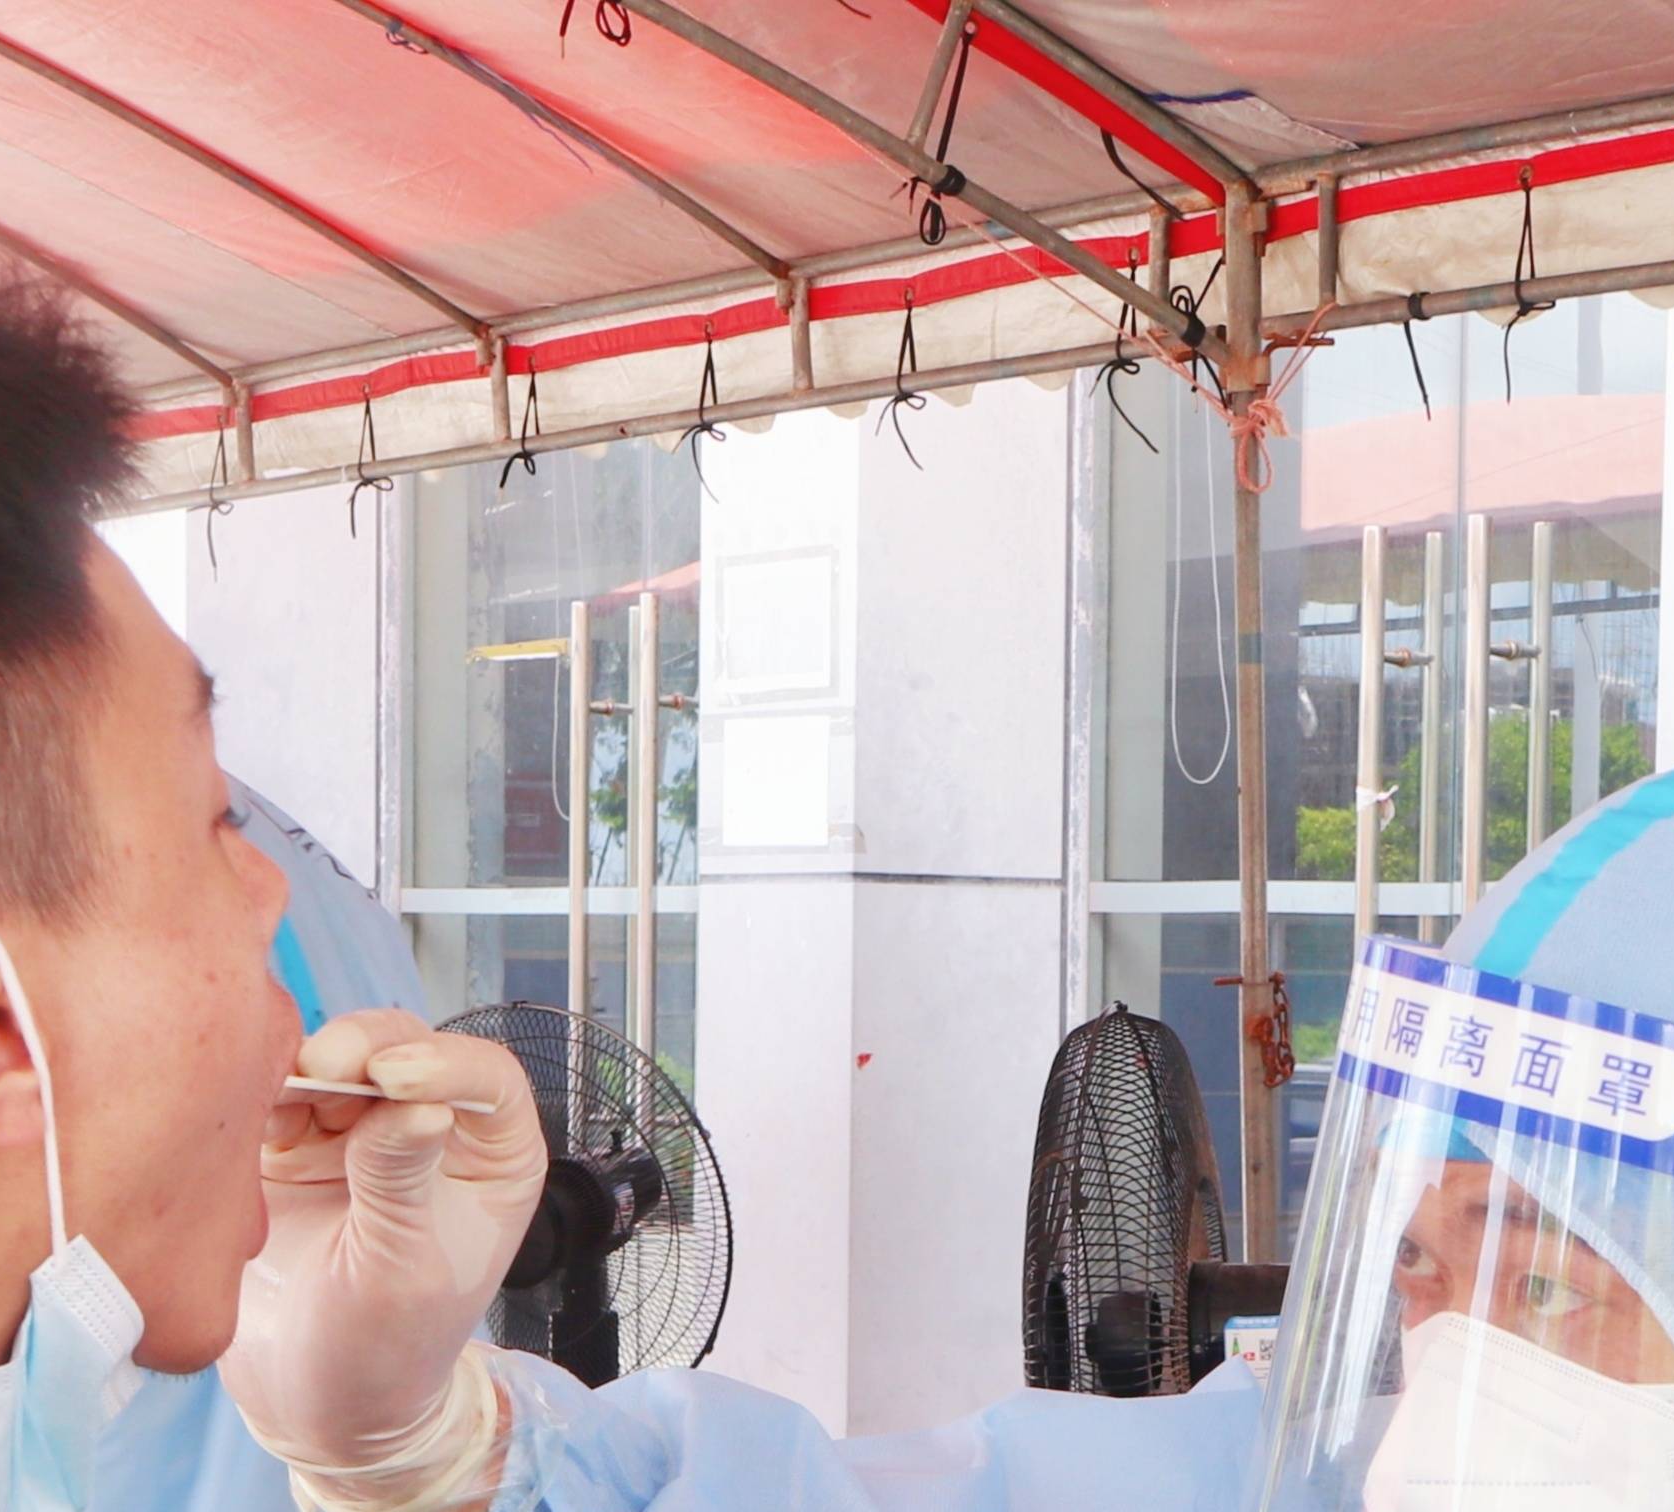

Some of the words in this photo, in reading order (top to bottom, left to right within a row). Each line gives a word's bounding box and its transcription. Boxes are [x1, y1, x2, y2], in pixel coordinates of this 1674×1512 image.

[1345, 978, 1655, 1118] 用隔离面罩
